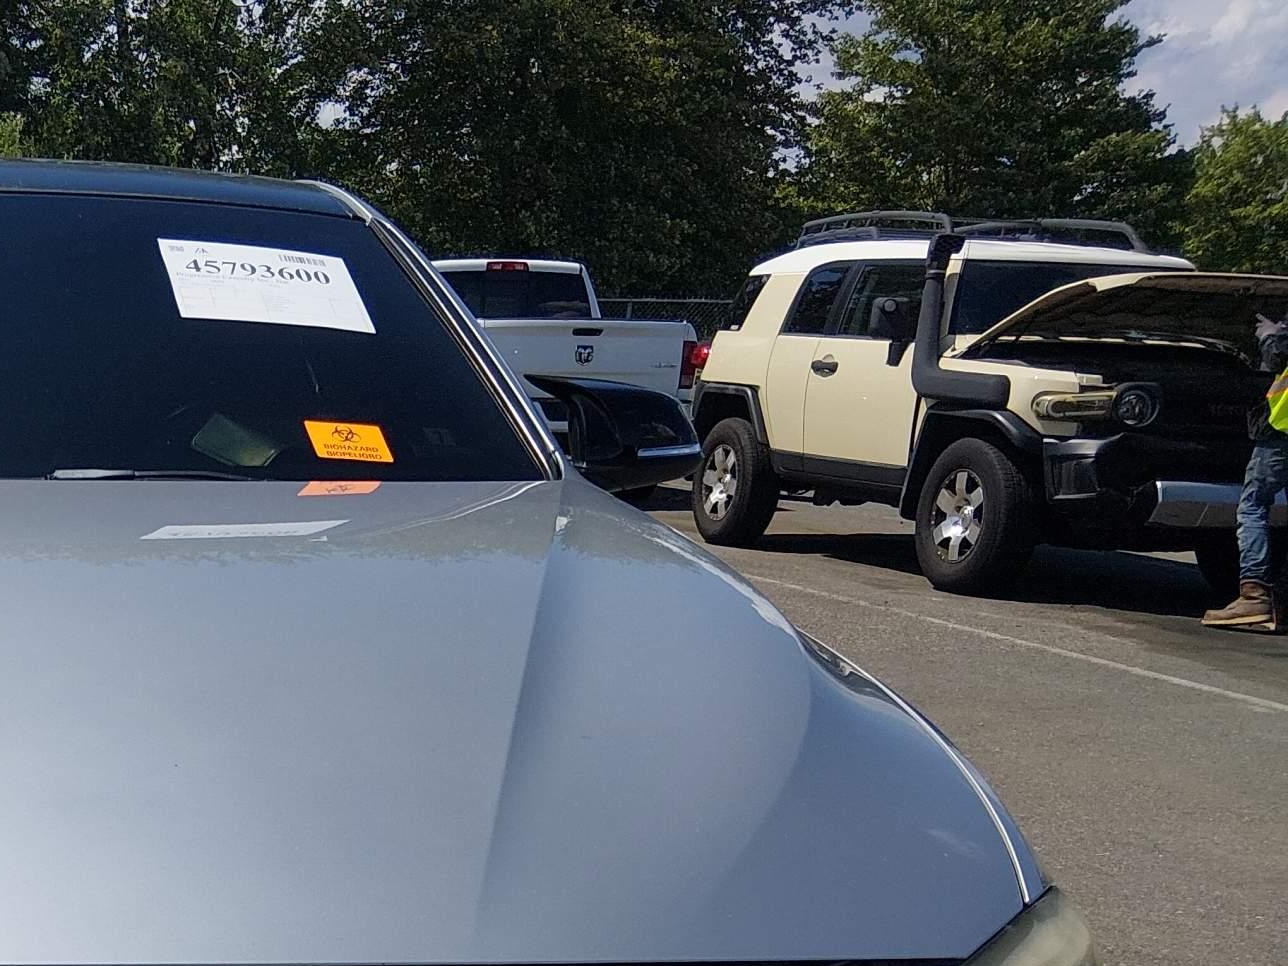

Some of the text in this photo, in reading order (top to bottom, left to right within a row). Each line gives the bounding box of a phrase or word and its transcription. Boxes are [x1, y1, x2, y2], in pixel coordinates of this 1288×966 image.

[185, 259, 331, 284] 45793600
[323, 443, 379, 453] BIOHAZARD
[326, 450, 382, 460] BIOPELIGRO
